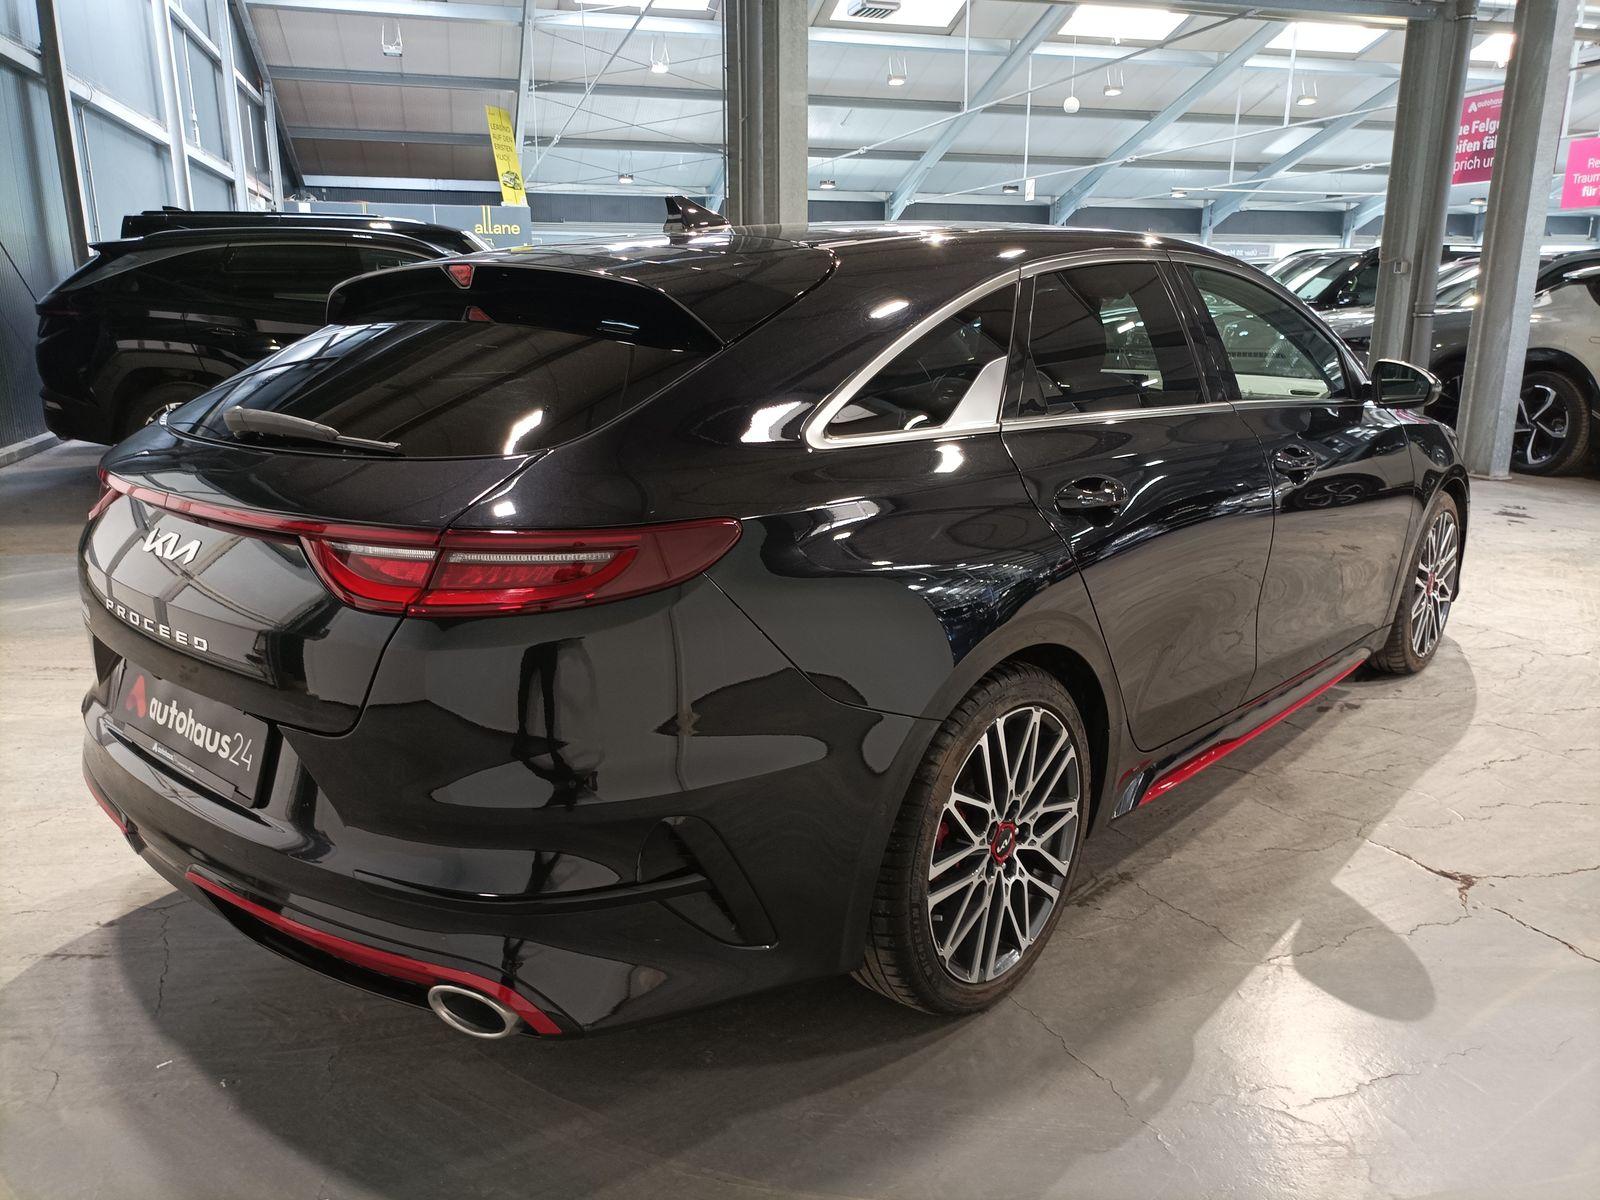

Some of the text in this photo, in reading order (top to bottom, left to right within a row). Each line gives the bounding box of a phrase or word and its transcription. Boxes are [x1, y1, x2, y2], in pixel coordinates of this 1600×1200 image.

[1581, 186, 1597, 198] für
[474, 205, 521, 236] allane
[142, 527, 203, 565] KIA
[105, 597, 210, 653] PROCEED
[149, 697, 253, 772] autohaus24
